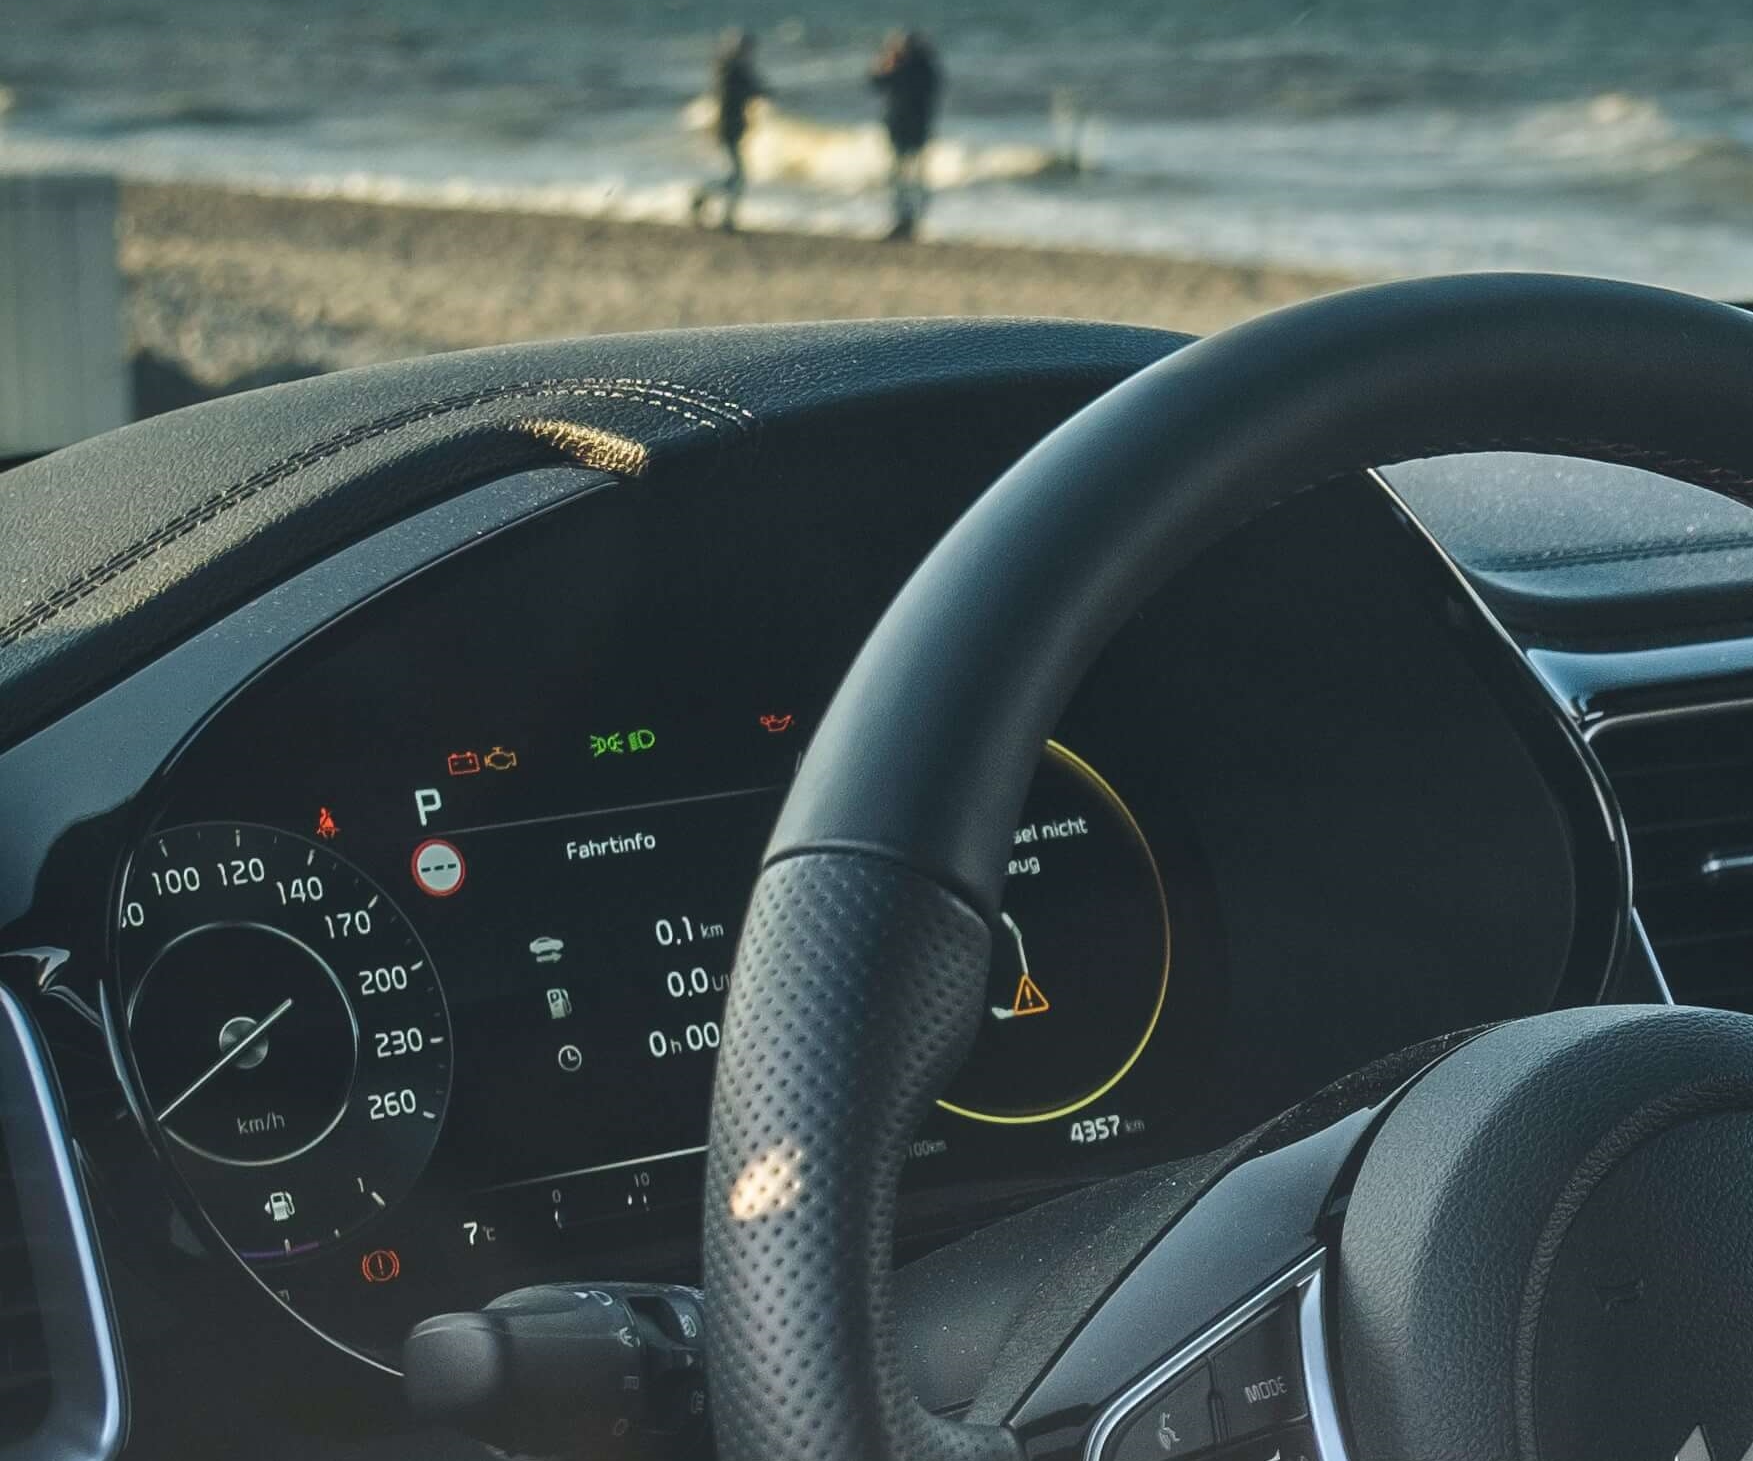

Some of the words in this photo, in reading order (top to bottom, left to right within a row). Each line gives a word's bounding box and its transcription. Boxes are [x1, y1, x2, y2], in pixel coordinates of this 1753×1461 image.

[414, 787, 443, 826] P
[1041, 815, 1089, 840] nicht
[565, 831, 657, 860] Fahrtinfo
[151, 866, 201, 897] 100
[216, 857, 265, 887] 120
[275, 875, 324, 906] 140
[323, 909, 372, 939] 170
[655, 915, 694, 946] 0.1
[358, 965, 408, 996] 200
[666, 966, 709, 998] 0.0
[374, 1027, 424, 1059] 230
[367, 1088, 417, 1121] 260
[236, 1110, 287, 1136] km/h
[1070, 1114, 1121, 1144] 4357
[462, 1220, 478, 1245] 7
[1243, 1375, 1288, 1404] MODE
